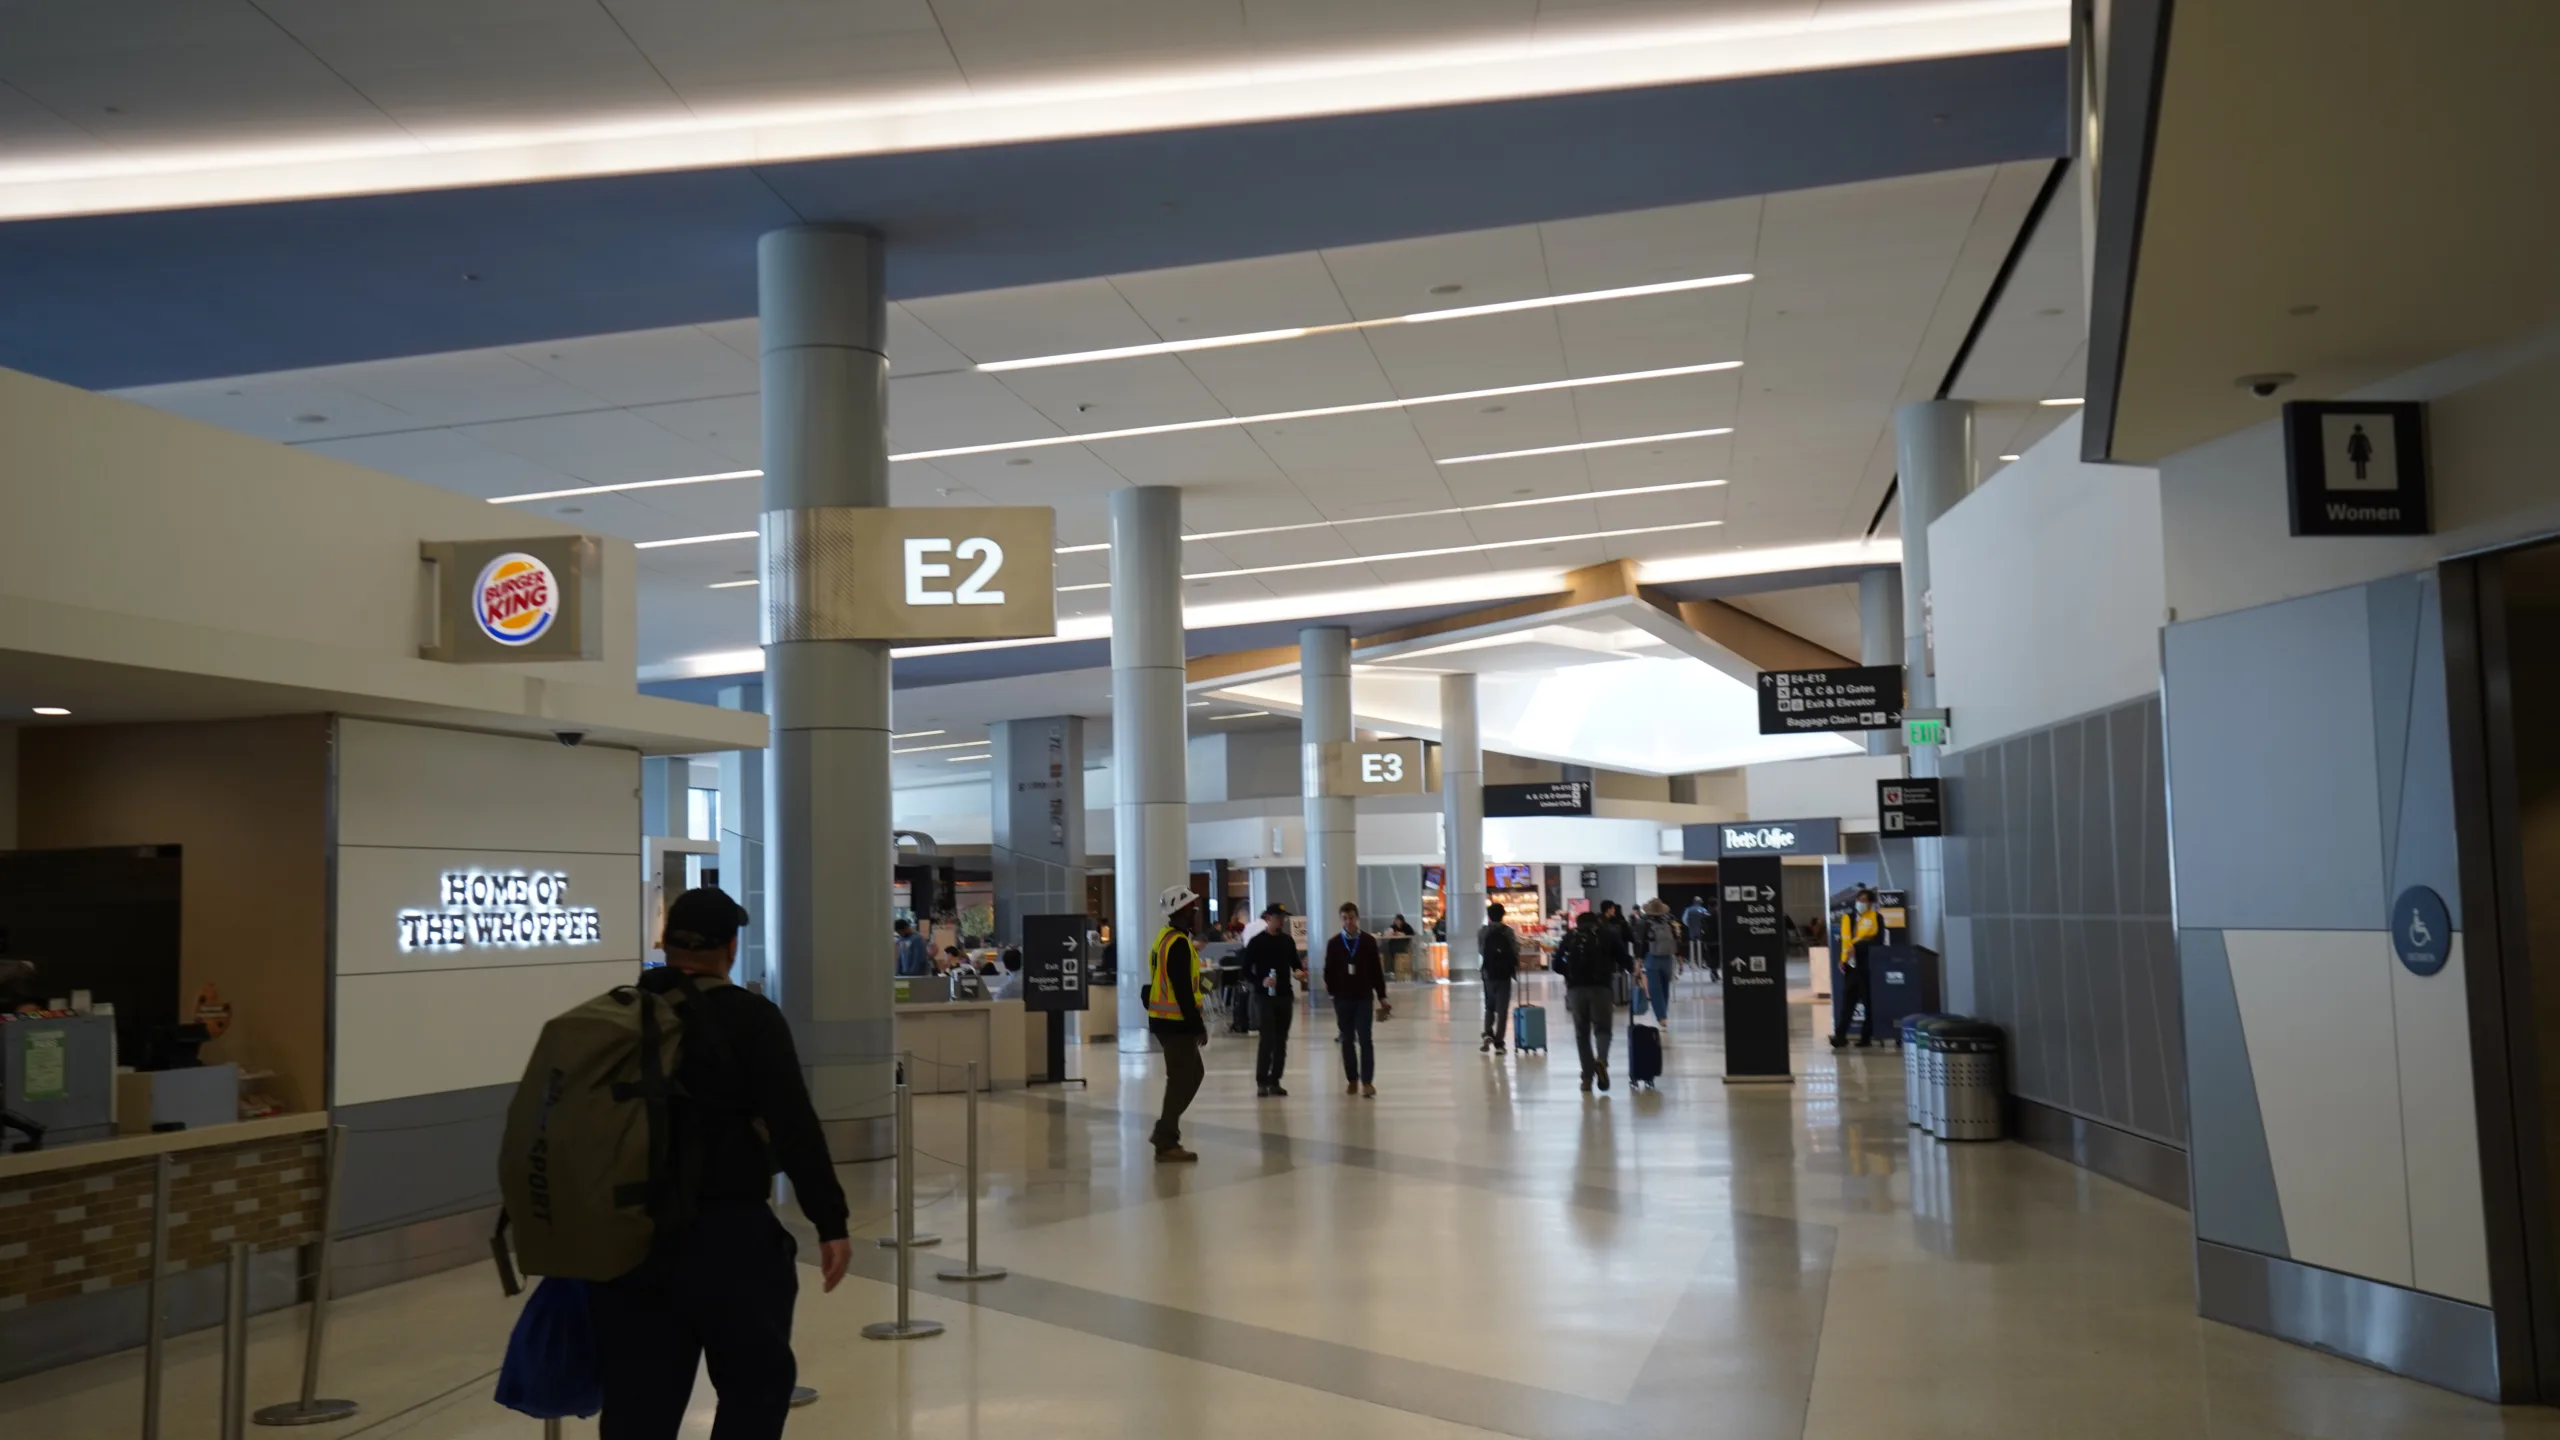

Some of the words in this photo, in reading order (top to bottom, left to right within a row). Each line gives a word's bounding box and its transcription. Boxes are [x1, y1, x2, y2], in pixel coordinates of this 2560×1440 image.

[2325, 503, 2401, 521] Women
[904, 537, 1005, 605] E2
[485, 570, 545, 602] BURGER
[488, 585, 547, 624] KING
[1816, 686, 1825, 696] C
[1825, 685, 1835, 695] &
[1836, 685, 1845, 694] D
[1847, 684, 1876, 694] Gates
[1805, 699, 1825, 709] Exit
[1826, 699, 1835, 708] &
[1836, 697, 1876, 708] Elevator
[1786, 717, 1828, 728] Baggage
[1830, 715, 1858, 725] Claim
[1909, 721, 1941, 745] EXIT
[1362, 753, 1403, 783] E3
[1724, 829, 1757, 849] Peet's
[1757, 828, 1796, 849] Coffee
[447, 874, 528, 906] HOME
[536, 875, 569, 905] OF
[1748, 904, 1766, 913] Exit
[1767, 904, 1775, 913] &
[401, 913, 465, 946] THE
[474, 911, 600, 942] WHOPPER
[1737, 916, 1776, 926] Baggage
[1750, 926, 1776, 935] Claim
[1732, 976, 1774, 986] Elevators
